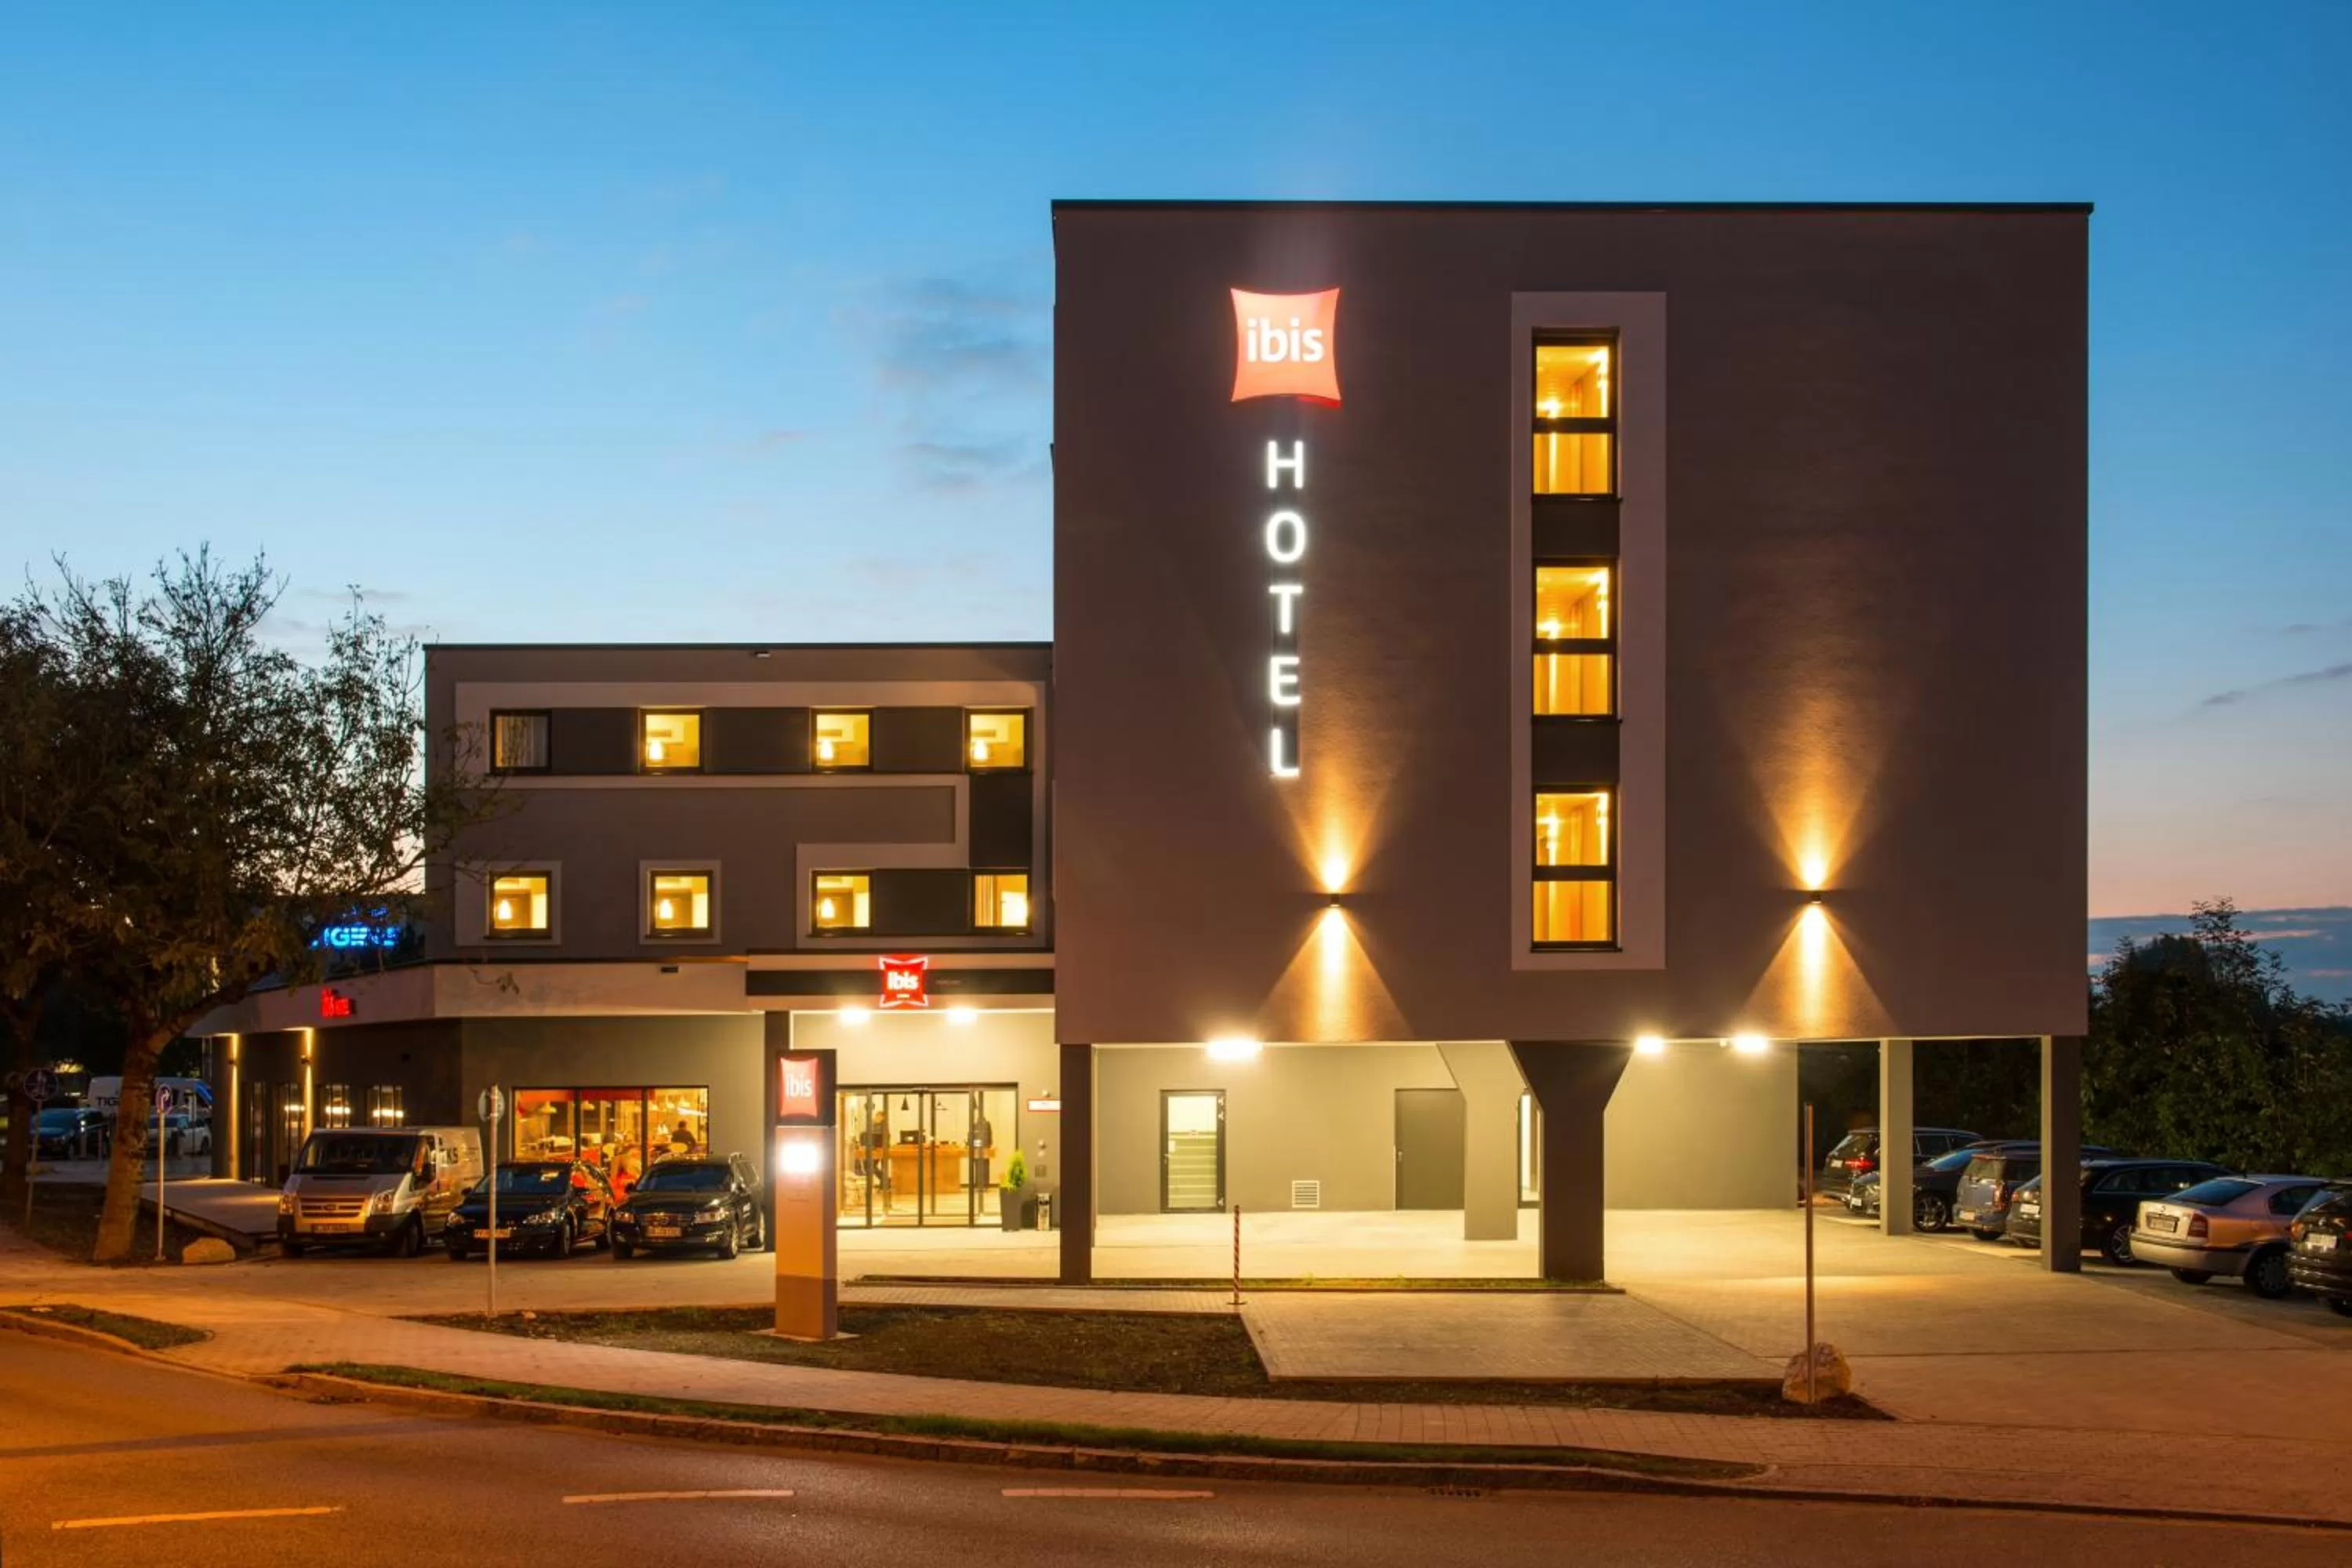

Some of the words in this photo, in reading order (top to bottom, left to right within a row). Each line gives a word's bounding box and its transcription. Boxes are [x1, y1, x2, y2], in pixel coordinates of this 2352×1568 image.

[1247, 318, 1324, 362] ibis
[1265, 440, 1307, 778] HOTEL
[887, 971, 919, 990] ibis
[786, 1073, 812, 1098] ibis
